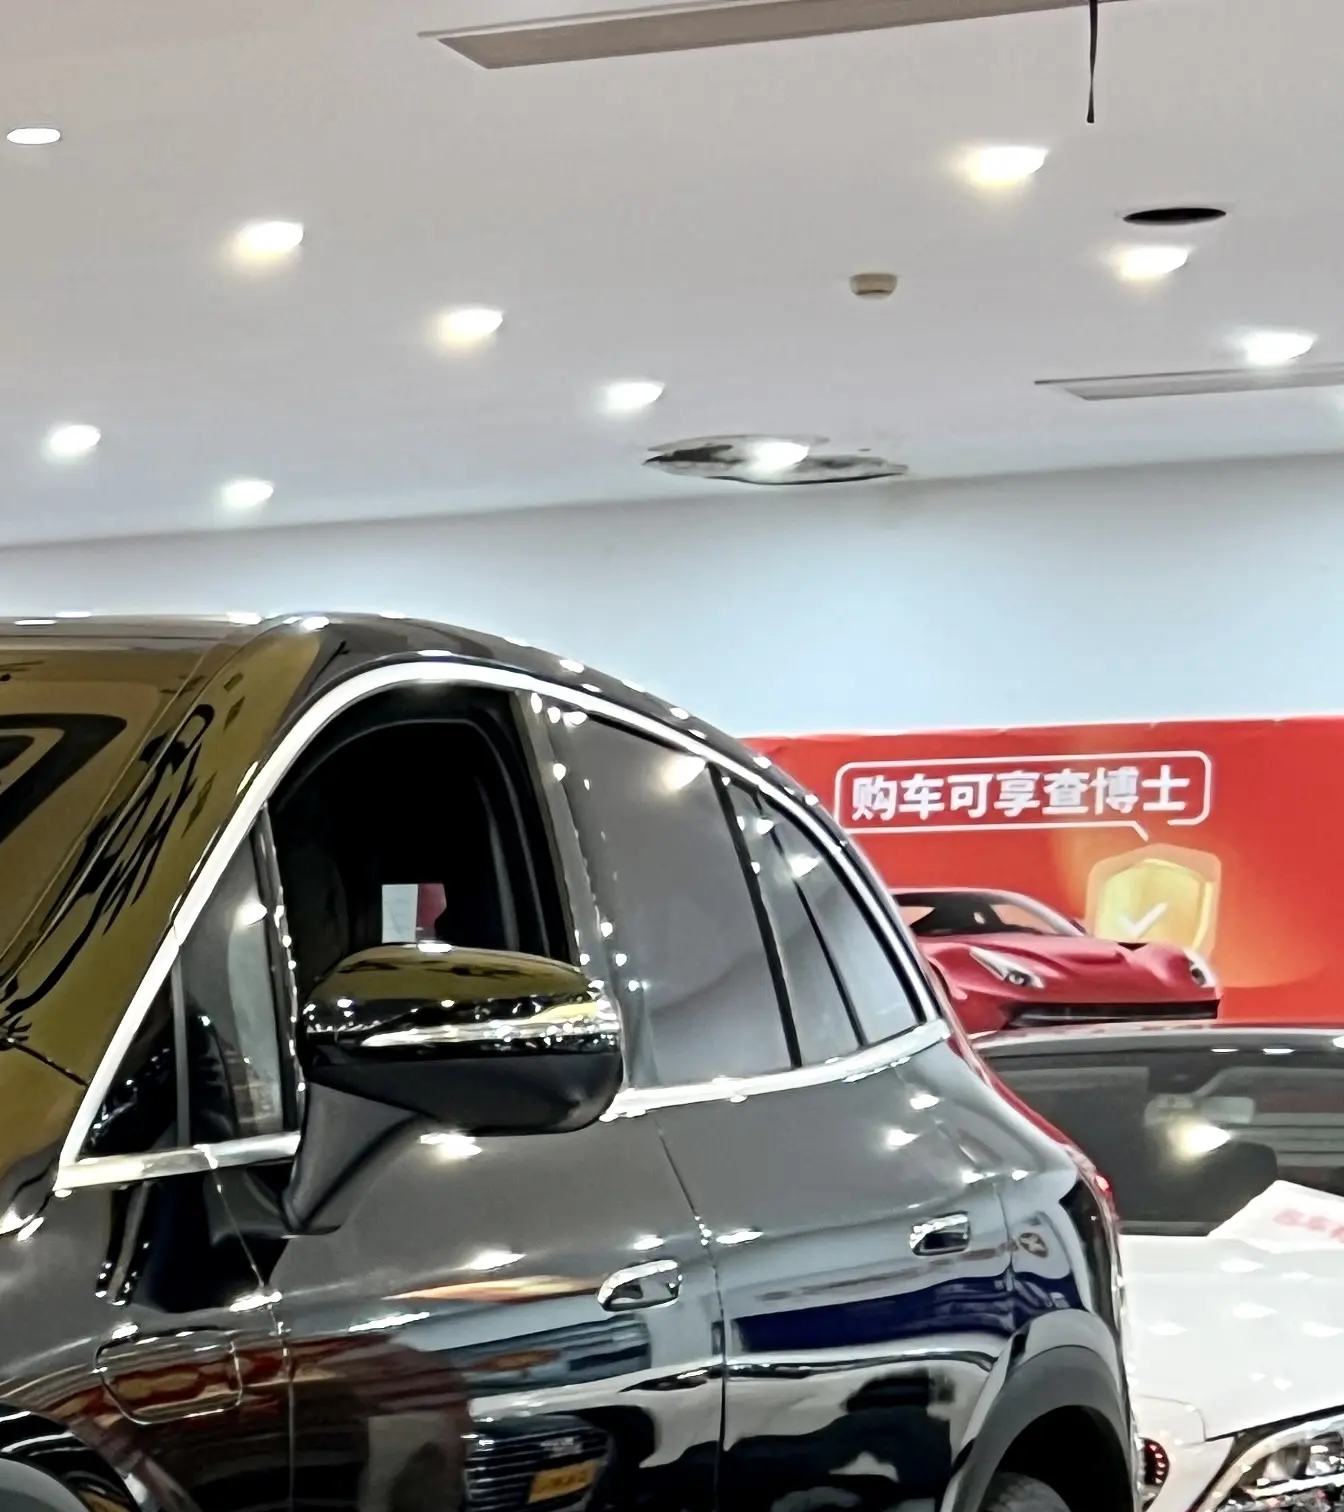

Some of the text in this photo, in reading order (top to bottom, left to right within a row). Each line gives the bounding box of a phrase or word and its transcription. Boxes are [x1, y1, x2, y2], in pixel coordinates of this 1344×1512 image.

[851, 763, 1191, 822] 购车可享查博士
